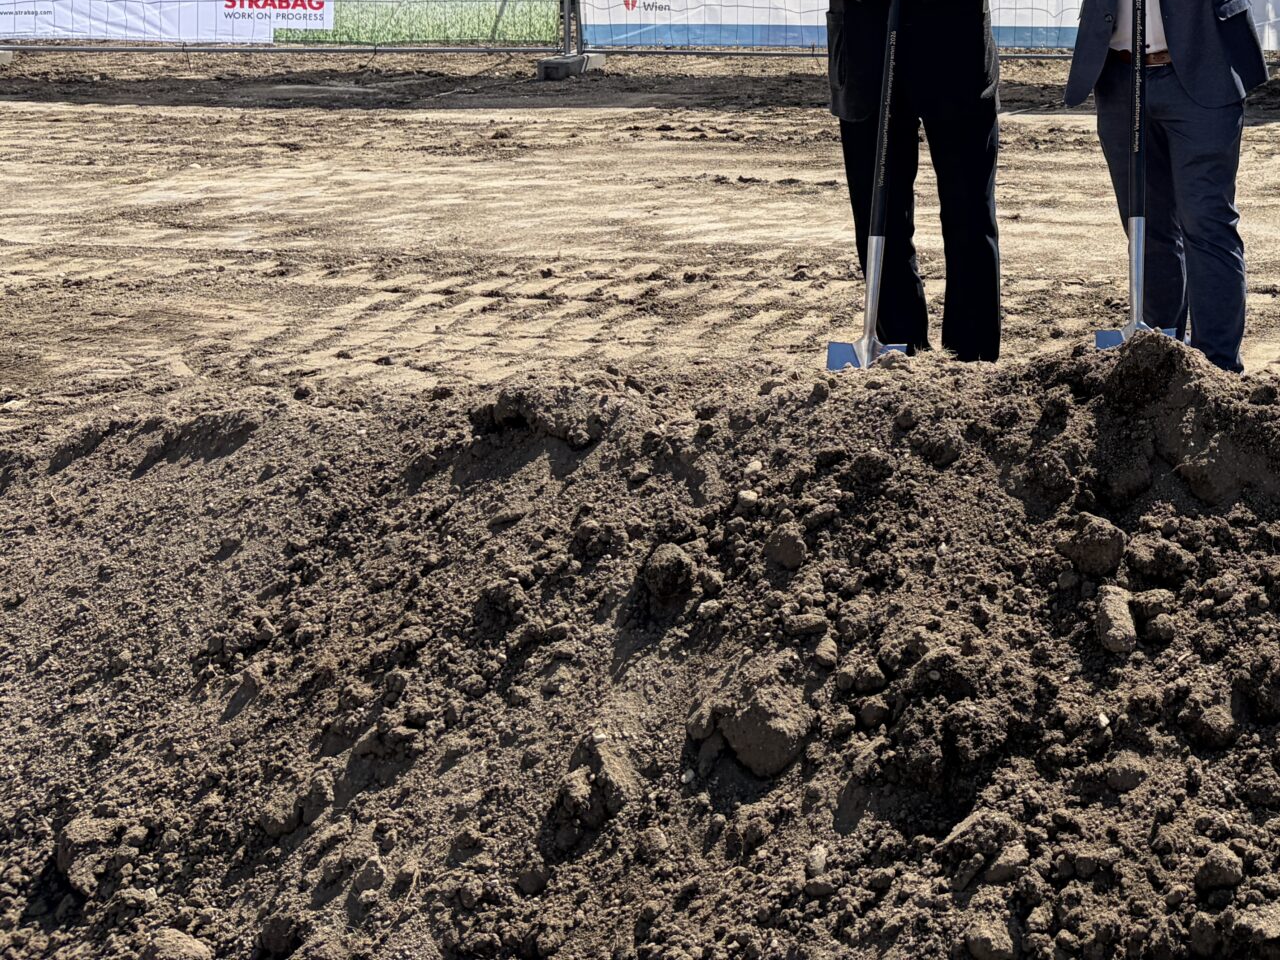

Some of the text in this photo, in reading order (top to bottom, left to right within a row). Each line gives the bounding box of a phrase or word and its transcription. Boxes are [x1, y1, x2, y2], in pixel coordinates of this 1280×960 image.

[643, 2, 670, 11] Wien
[224, 12, 325, 21] WORK ON PROGRESS
